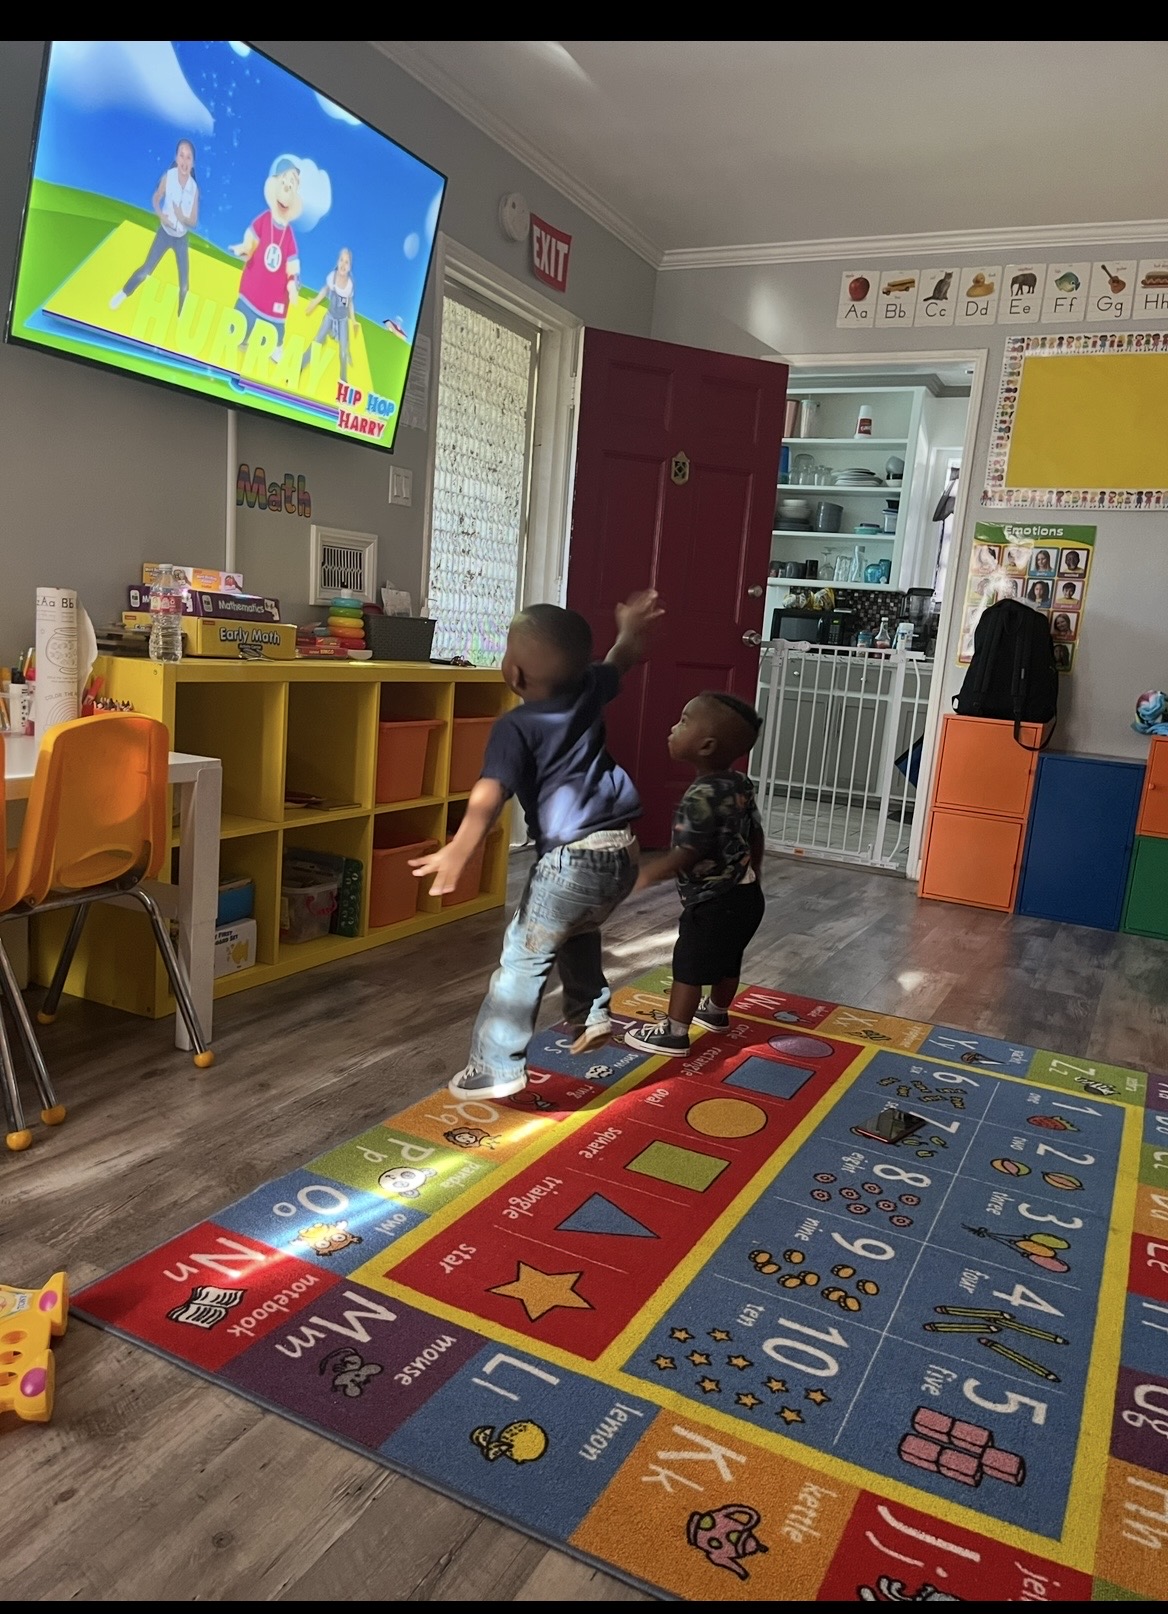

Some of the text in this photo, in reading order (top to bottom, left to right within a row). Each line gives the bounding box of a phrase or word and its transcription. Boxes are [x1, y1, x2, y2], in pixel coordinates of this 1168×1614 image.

[533, 224, 568, 281] EXIT
[845, 304, 867, 318] Aa
[885, 304, 906, 318] Bb
[926, 302, 946, 317] Cc
[966, 300, 989, 316] Dd
[1010, 299, 1031, 314] Ee
[1054, 297, 1077, 312] Ff
[1097, 296, 1123, 317] Gg
[1145, 294, 1168, 309] Hh
[131, 275, 337, 395] HURRAY
[336, 382, 395, 416] HIP HOP
[338, 409, 384, 437] HARRY
[236, 463, 311, 517] Math
[1005, 525, 1064, 537] Emotions
[61, 597, 74, 608] Bb
[218, 600, 265, 613] Mathematics
[220, 627, 281, 645] Early Math
[734, 993, 787, 1011] Ww
[726, 1023, 754, 1040] circle
[929, 1035, 979, 1050] Yy
[613, 1053, 639, 1069] snow
[676, 1046, 723, 1078] rectangle
[1047, 1060, 1096, 1077] Zz
[566, 1084, 595, 1100] ring
[933, 1072, 980, 1087] 6
[644, 1088, 670, 1108] oval
[1052, 1101, 1102, 1117] 1
[429, 1100, 501, 1128] Qq
[909, 1111, 960, 1133] 7
[361, 1137, 436, 1165] Pp
[578, 1126, 623, 1159] square
[1036, 1142, 1096, 1166] 2
[841, 1151, 866, 1175] eight
[872, 1164, 931, 1188] 8
[439, 1162, 484, 1192] panda
[272, 1184, 350, 1218] Oo
[501, 1176, 563, 1220] triangle
[986, 1190, 1015, 1217] three
[374, 1212, 408, 1237] owl
[794, 1217, 820, 1242] nine
[1018, 1202, 1084, 1230] 3
[162, 1236, 267, 1284] Nn
[438, 1243, 478, 1275] star
[831, 1232, 896, 1262] 9
[958, 1268, 990, 1295] four
[226, 1273, 320, 1338] notebook
[992, 1283, 1065, 1317] 4
[275, 1290, 398, 1360] Mm
[736, 1303, 766, 1328] ten
[394, 1332, 458, 1387] mouse
[761, 1317, 852, 1378] 10
[920, 1364, 959, 1398] five
[962, 1377, 1049, 1427] 5
[578, 1405, 646, 1462] lemon
[641, 1425, 748, 1496] Kk
[779, 1483, 838, 1546] kettle
[865, 1504, 982, 1578] Jj
